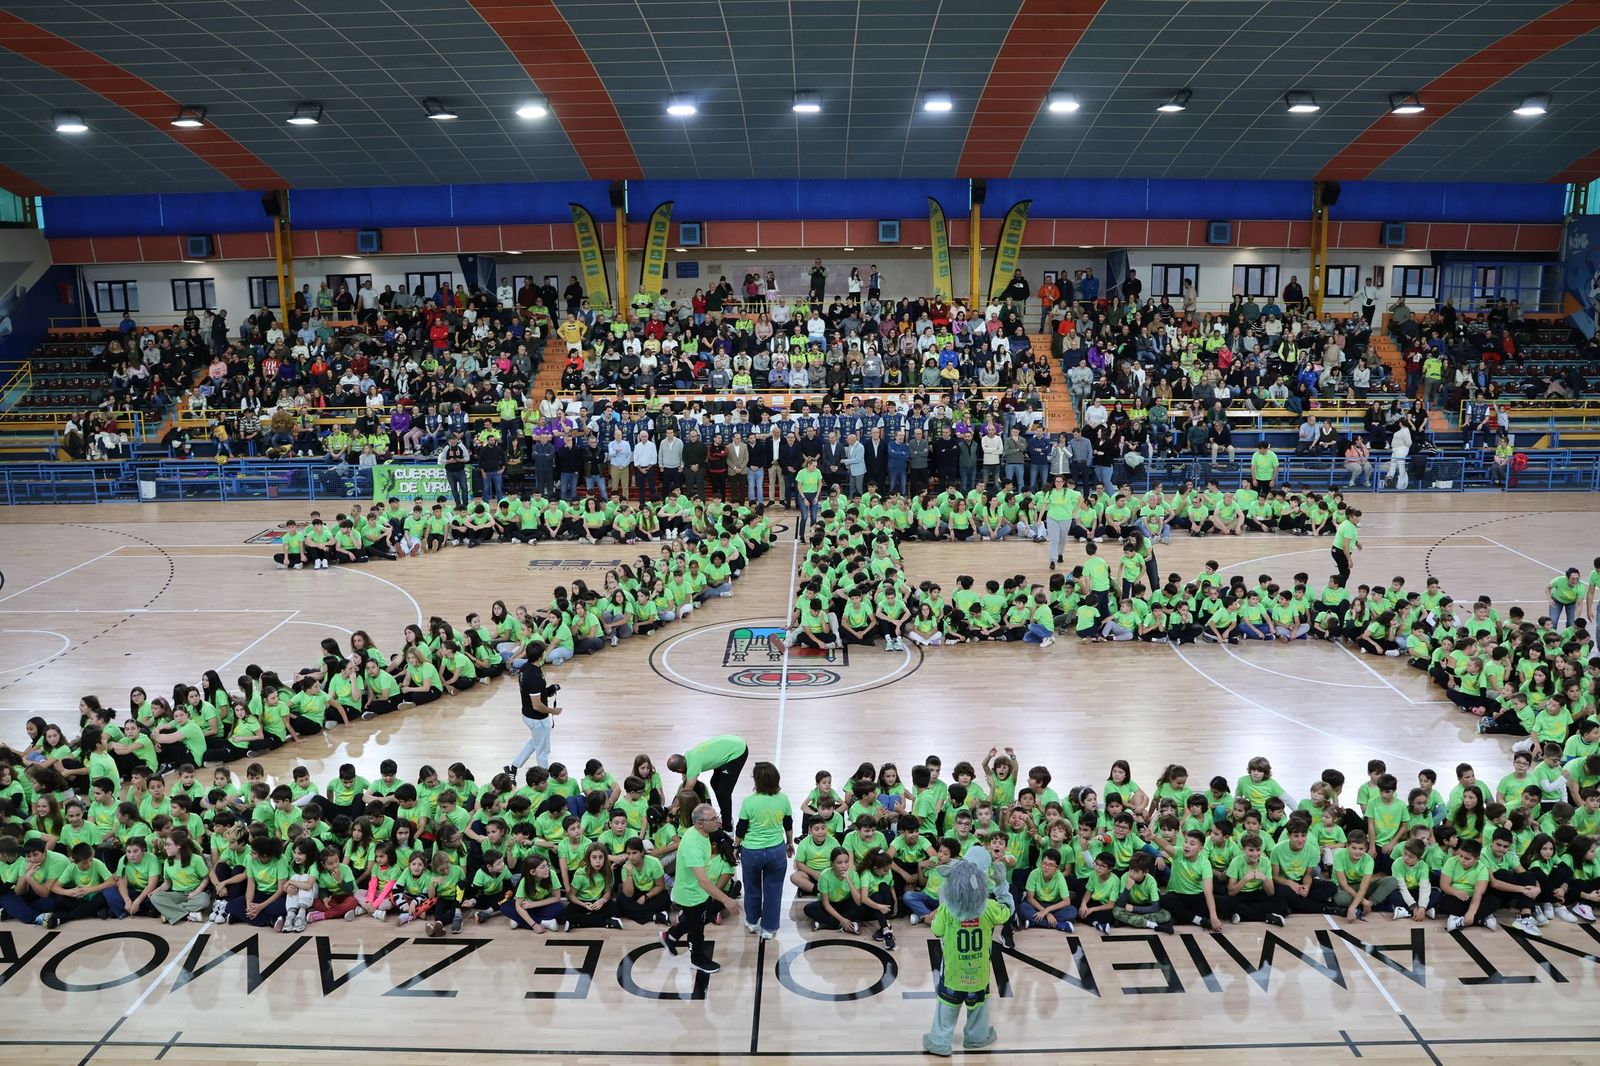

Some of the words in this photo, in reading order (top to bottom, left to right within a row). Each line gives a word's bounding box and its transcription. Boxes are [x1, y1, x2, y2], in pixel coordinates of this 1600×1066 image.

[399, 481, 418, 493] DE
[957, 928, 983, 953] 00
[524, 939, 716, 1000] DE
